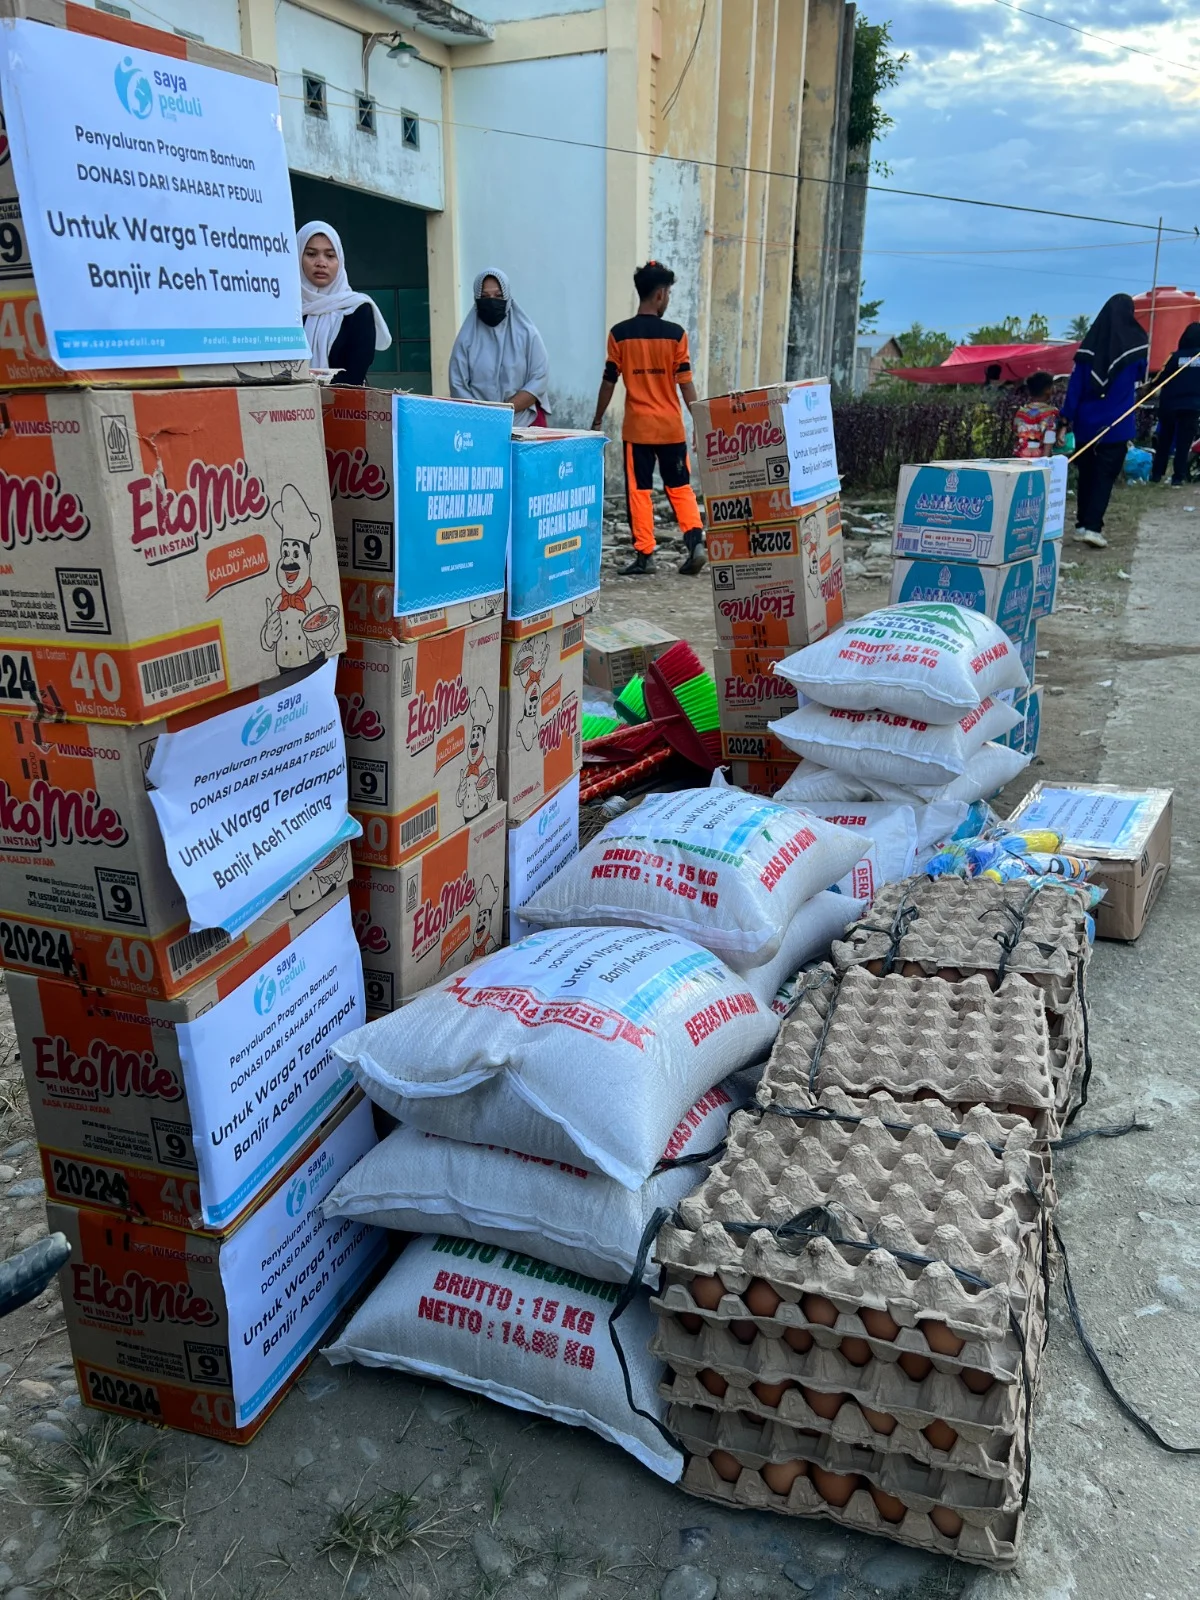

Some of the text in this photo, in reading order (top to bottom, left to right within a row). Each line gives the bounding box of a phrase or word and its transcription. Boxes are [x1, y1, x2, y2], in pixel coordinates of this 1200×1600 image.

[154, 69, 187, 92] saya
[159, 94, 203, 117] peduli
[75, 125, 255, 171] Penyaluran Program Bantuan
[77, 164, 262, 204] DONASI DARI SAHABAT PEDULI
[0, 223, 23, 263] 9
[47, 210, 120, 241] Untuk
[122, 216, 196, 250] Warga
[198, 224, 290, 257] Terdampak
[88, 263, 280, 299] Banjir Aceh Tamiang
[14, 421, 79, 434] WINGSFOOD
[269, 409, 315, 422] WINGSFOOD
[333, 409, 392, 421] WINGSFOOD
[705, 420, 785, 459] EkoMie
[416, 466, 504, 492] PENYERAHAN BANTUAN
[773, 465, 785, 478] 9
[127, 460, 267, 546] EkoMie
[427, 493, 494, 521] BENCANA BANJIR
[570, 485, 596, 508] BANTUAN
[713, 498, 753, 521] 20224
[144, 537, 195, 560] MI INSTAN
[228, 547, 245, 559] RASA
[364, 535, 382, 560] 9
[711, 540, 734, 562] 40
[60, 572, 98, 580] TUMPUKAN
[209, 553, 266, 581] KALDU AYAM
[72, 587, 95, 620] 9
[347, 583, 393, 623] 40
[719, 593, 795, 623] EkoMie
[845, 627, 959, 655] MUTU TERJAMIN
[849, 640, 895, 654] BRUTTO
[70, 651, 121, 703] 40
[919, 657, 938, 669] KG
[724, 674, 798, 699] EkoMie
[75, 701, 126, 717] bks/packs
[274, 702, 309, 727] peduli
[277, 692, 302, 713] saya
[406, 676, 469, 745] EkoMie
[830, 709, 928, 731] NETTO KG
[58, 743, 120, 760] WINGSFOOD
[194, 720, 337, 787] Penyaluran Program Bantuan
[728, 737, 764, 758] 20224
[190, 739, 337, 815] DONASI DARI SAHABAT PEDULI
[360, 771, 378, 795] 9
[178, 828, 224, 868] Untuk
[221, 799, 270, 840] Warga
[212, 794, 332, 890] Banjir Aceh Tamiang
[100, 872, 135, 880] TUMPUKAN
[602, 848, 664, 869] BRUTTO
[678, 863, 695, 882] 15
[698, 869, 718, 887] KG
[592, 865, 719, 909] NETTO KG
[857, 867, 870, 900] BERA
[110, 885, 132, 914] 9
[412, 871, 477, 952] EkoMie
[106, 937, 153, 983] 40
[276, 951, 297, 976] saya
[279, 957, 307, 990] peduli
[598, 961, 631, 984] Banjir
[109, 976, 159, 996] bks/packs
[367, 981, 385, 1000] 9
[229, 964, 338, 1068] Penyaluran Program Bantuan
[685, 1005, 721, 1047] BERAS
[231, 981, 339, 1093] DONASI DARI SAHABAT PEDULI
[32, 1036, 181, 1102] EkoMie
[211, 993, 356, 1147] Untuk Warga Terdampak
[60, 1085, 96, 1099] INSTAN
[234, 1083, 302, 1161] Banjir Aceh
[165, 1134, 187, 1159] 9
[307, 1151, 327, 1176] saya
[152, 1244, 213, 1264] WINGSFOOD
[261, 1220, 307, 1271] Penyaluran
[261, 1233, 313, 1295] DONASI DARI
[71, 1264, 215, 1325] EkoMie
[243, 1296, 284, 1347] Untuk
[284, 1249, 326, 1298] Warga
[433, 1269, 596, 1336] BRUTTO 15 KG
[263, 1272, 330, 1357] Banjir Aceh
[418, 1295, 596, 1371] NETTO KG
[199, 1354, 220, 1377] 9
[90, 1371, 162, 1416] 20224
[191, 1393, 235, 1428] 40
